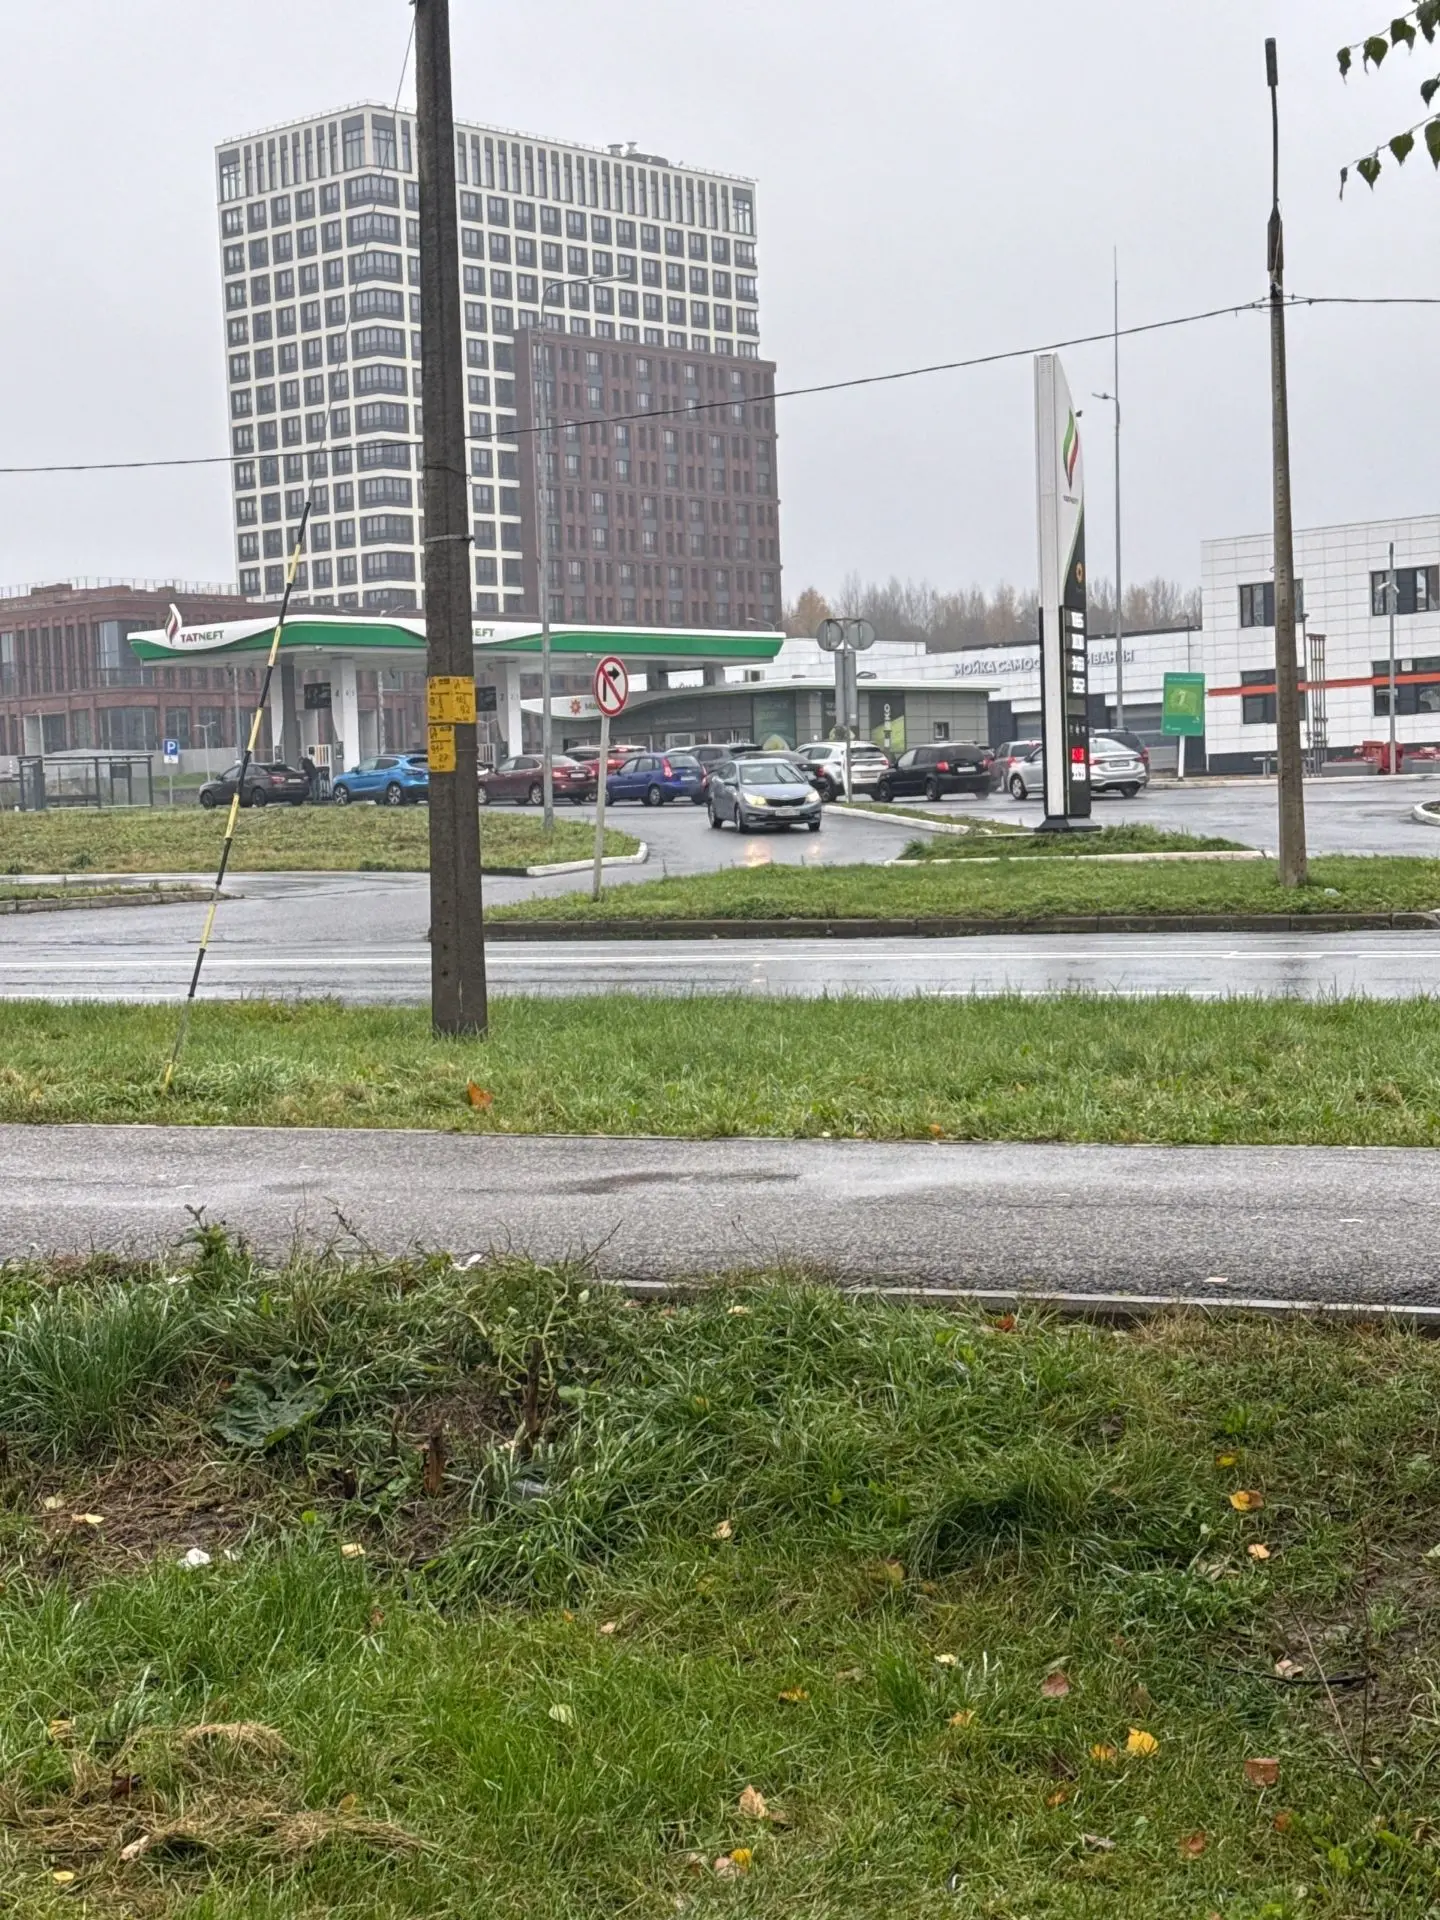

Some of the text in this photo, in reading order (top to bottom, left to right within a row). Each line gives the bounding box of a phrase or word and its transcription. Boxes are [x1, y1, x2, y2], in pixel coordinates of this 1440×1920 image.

[180, 630, 224, 643] TATNEFT
[954, 659, 997, 676] МОЙКА
[167, 741, 176, 754] P
